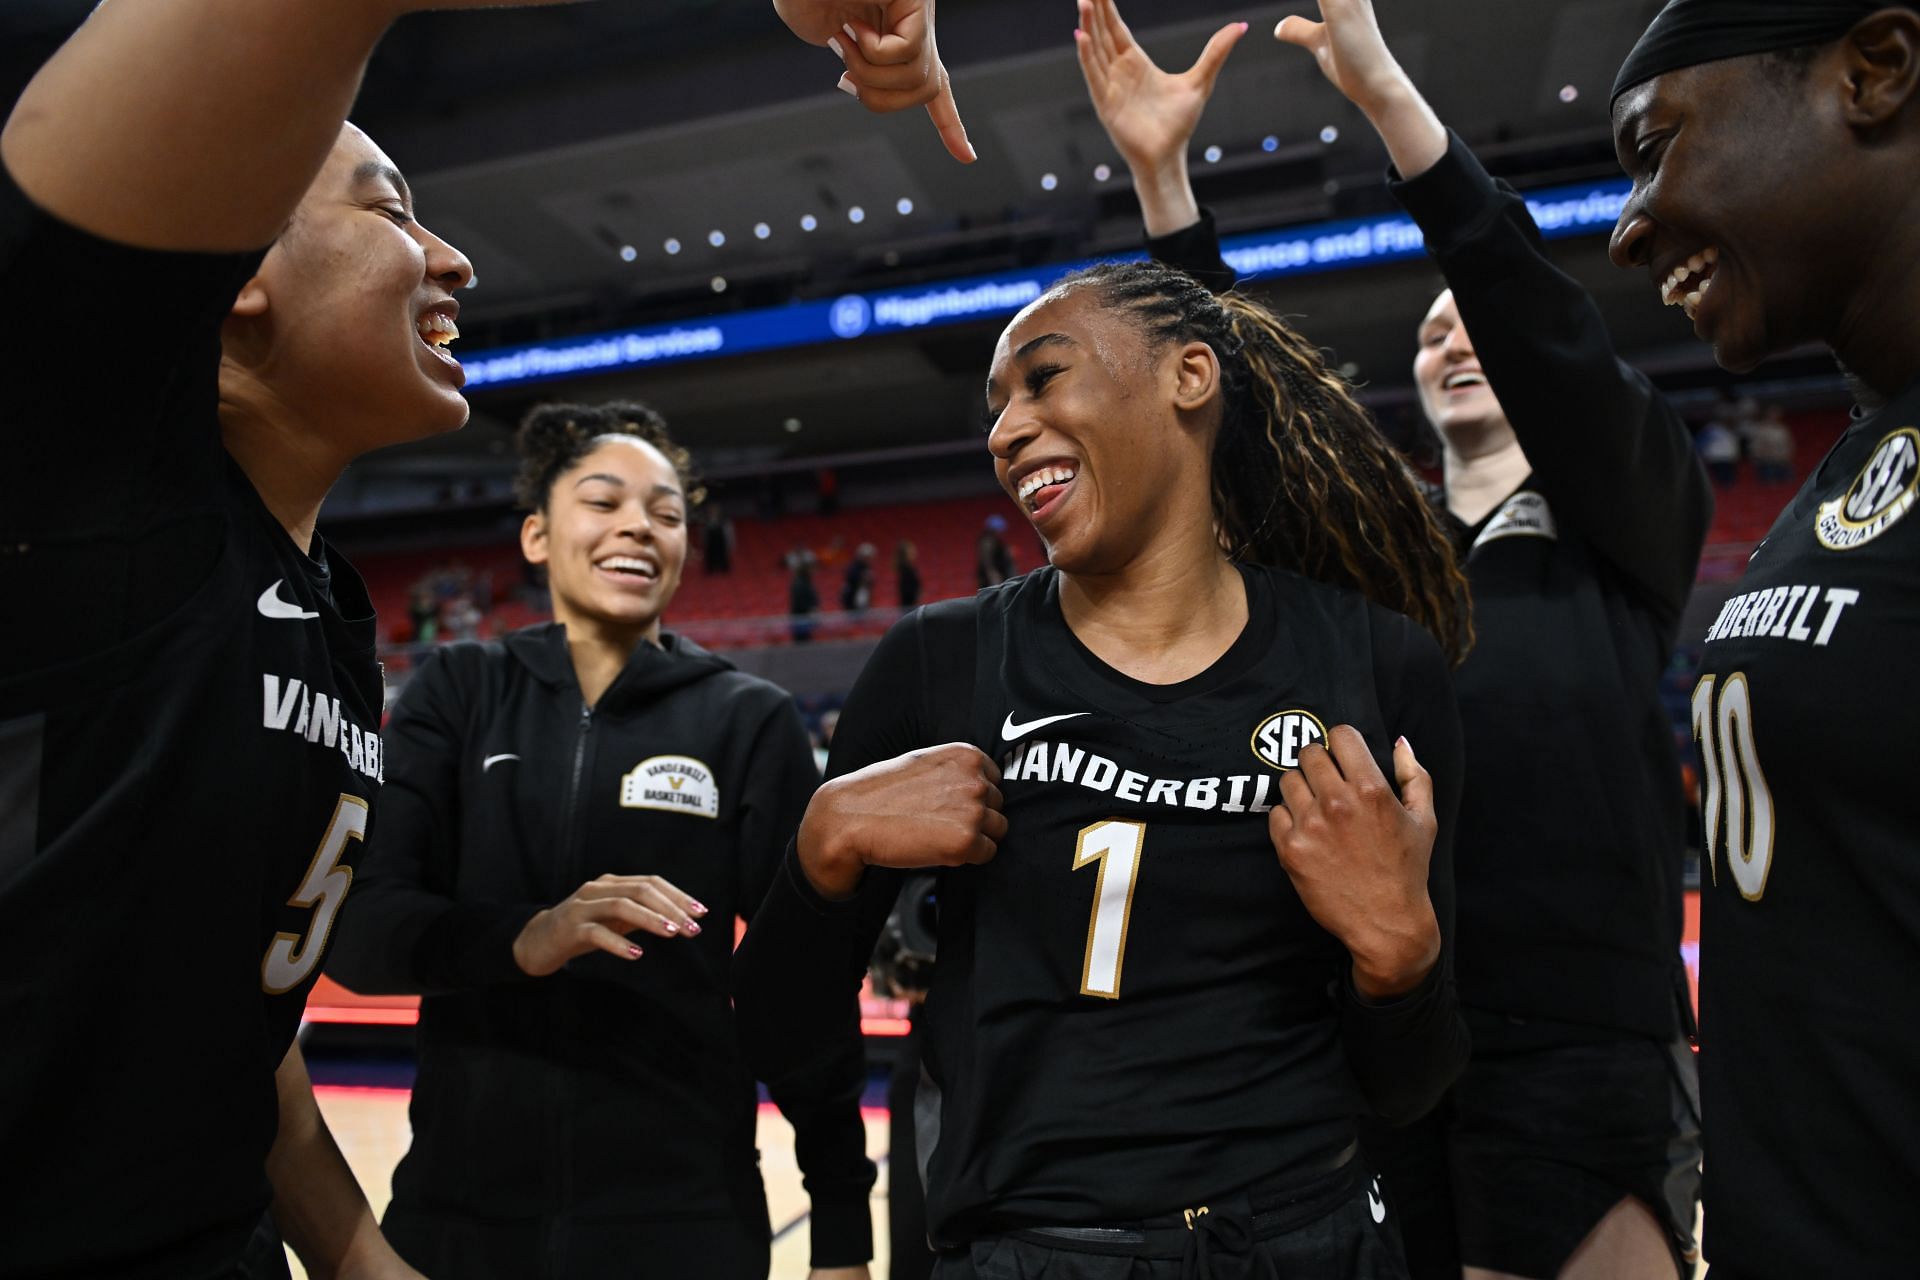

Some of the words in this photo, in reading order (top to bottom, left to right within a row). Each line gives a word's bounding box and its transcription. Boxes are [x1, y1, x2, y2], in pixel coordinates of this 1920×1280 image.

[1312, 226, 1371, 263] and
[875, 279, 1041, 327] Higginbotham
[485, 351, 524, 381] and
[526, 337, 621, 377] Financial
[623, 326, 723, 363] Services
[1847, 436, 1917, 519] SEC
[1820, 514, 1893, 545] GRADUATE
[1704, 585, 1860, 647] NDERBILT
[644, 789, 702, 808] BASKETBALL
[646, 763, 707, 783] VANDERBILT
[1003, 740, 1273, 813] VANDERBIL
[1692, 671, 1776, 902] 10
[261, 793, 369, 996] 5
[1072, 816, 1147, 999] 1
